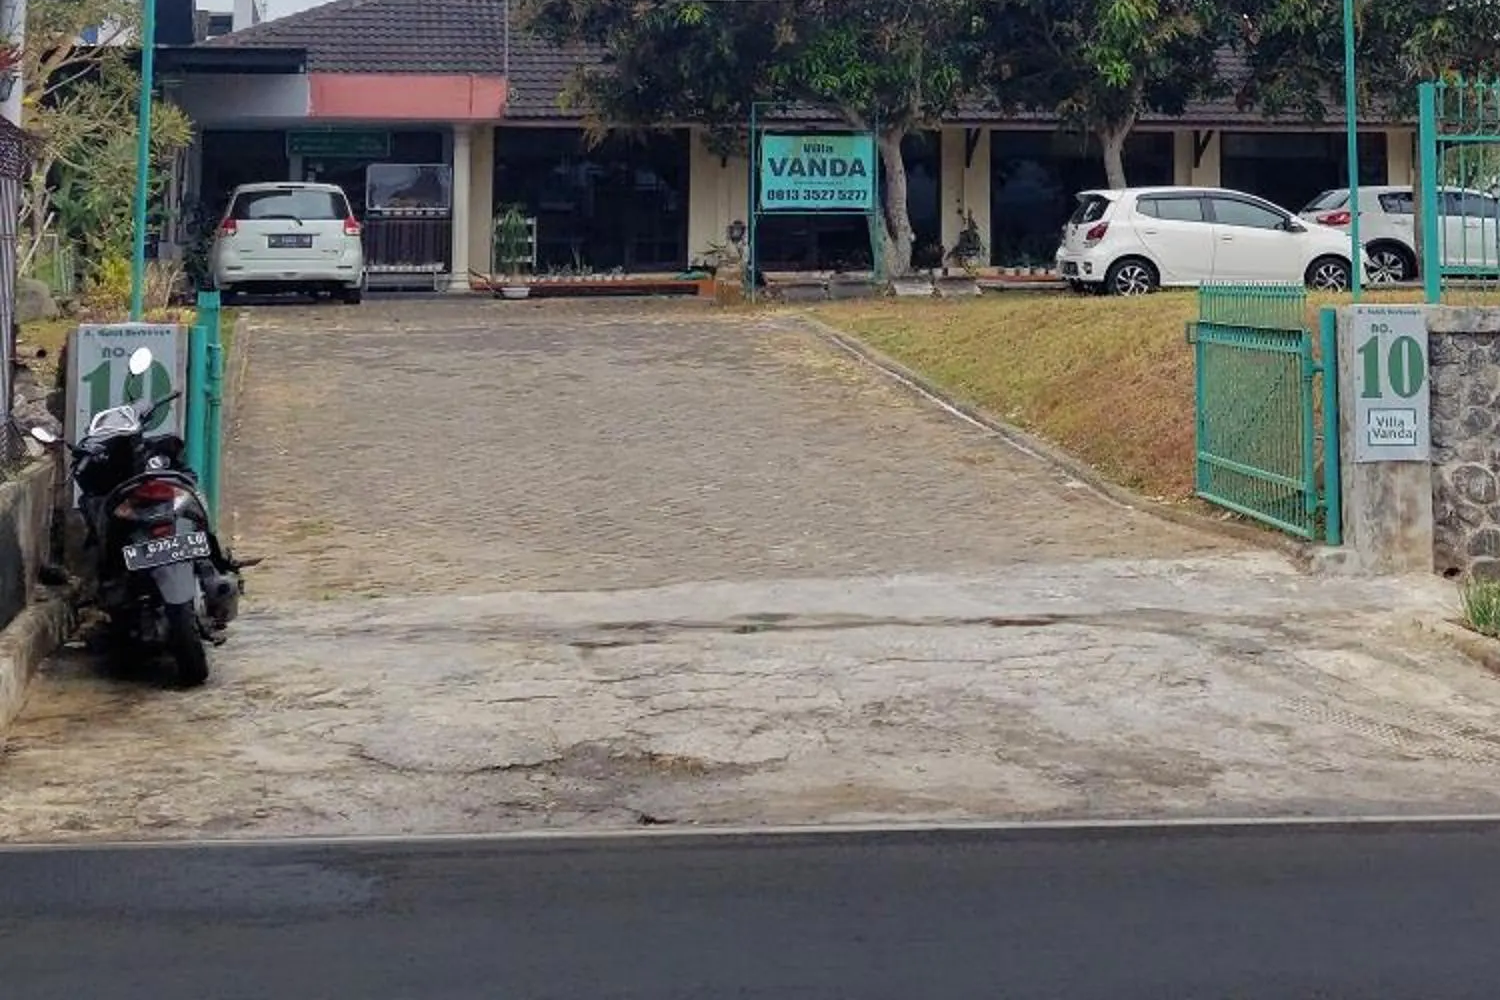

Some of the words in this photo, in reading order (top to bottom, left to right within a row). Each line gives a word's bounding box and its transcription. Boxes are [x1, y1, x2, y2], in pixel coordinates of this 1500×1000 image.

[803, 143, 833, 153] Villa
[767, 158, 867, 176] VANDA
[1357, 335, 1424, 398] 10
[82, 359, 171, 432] 10
[1376, 415, 1405, 428] Villa
[1372, 427, 1413, 439] Vanda
